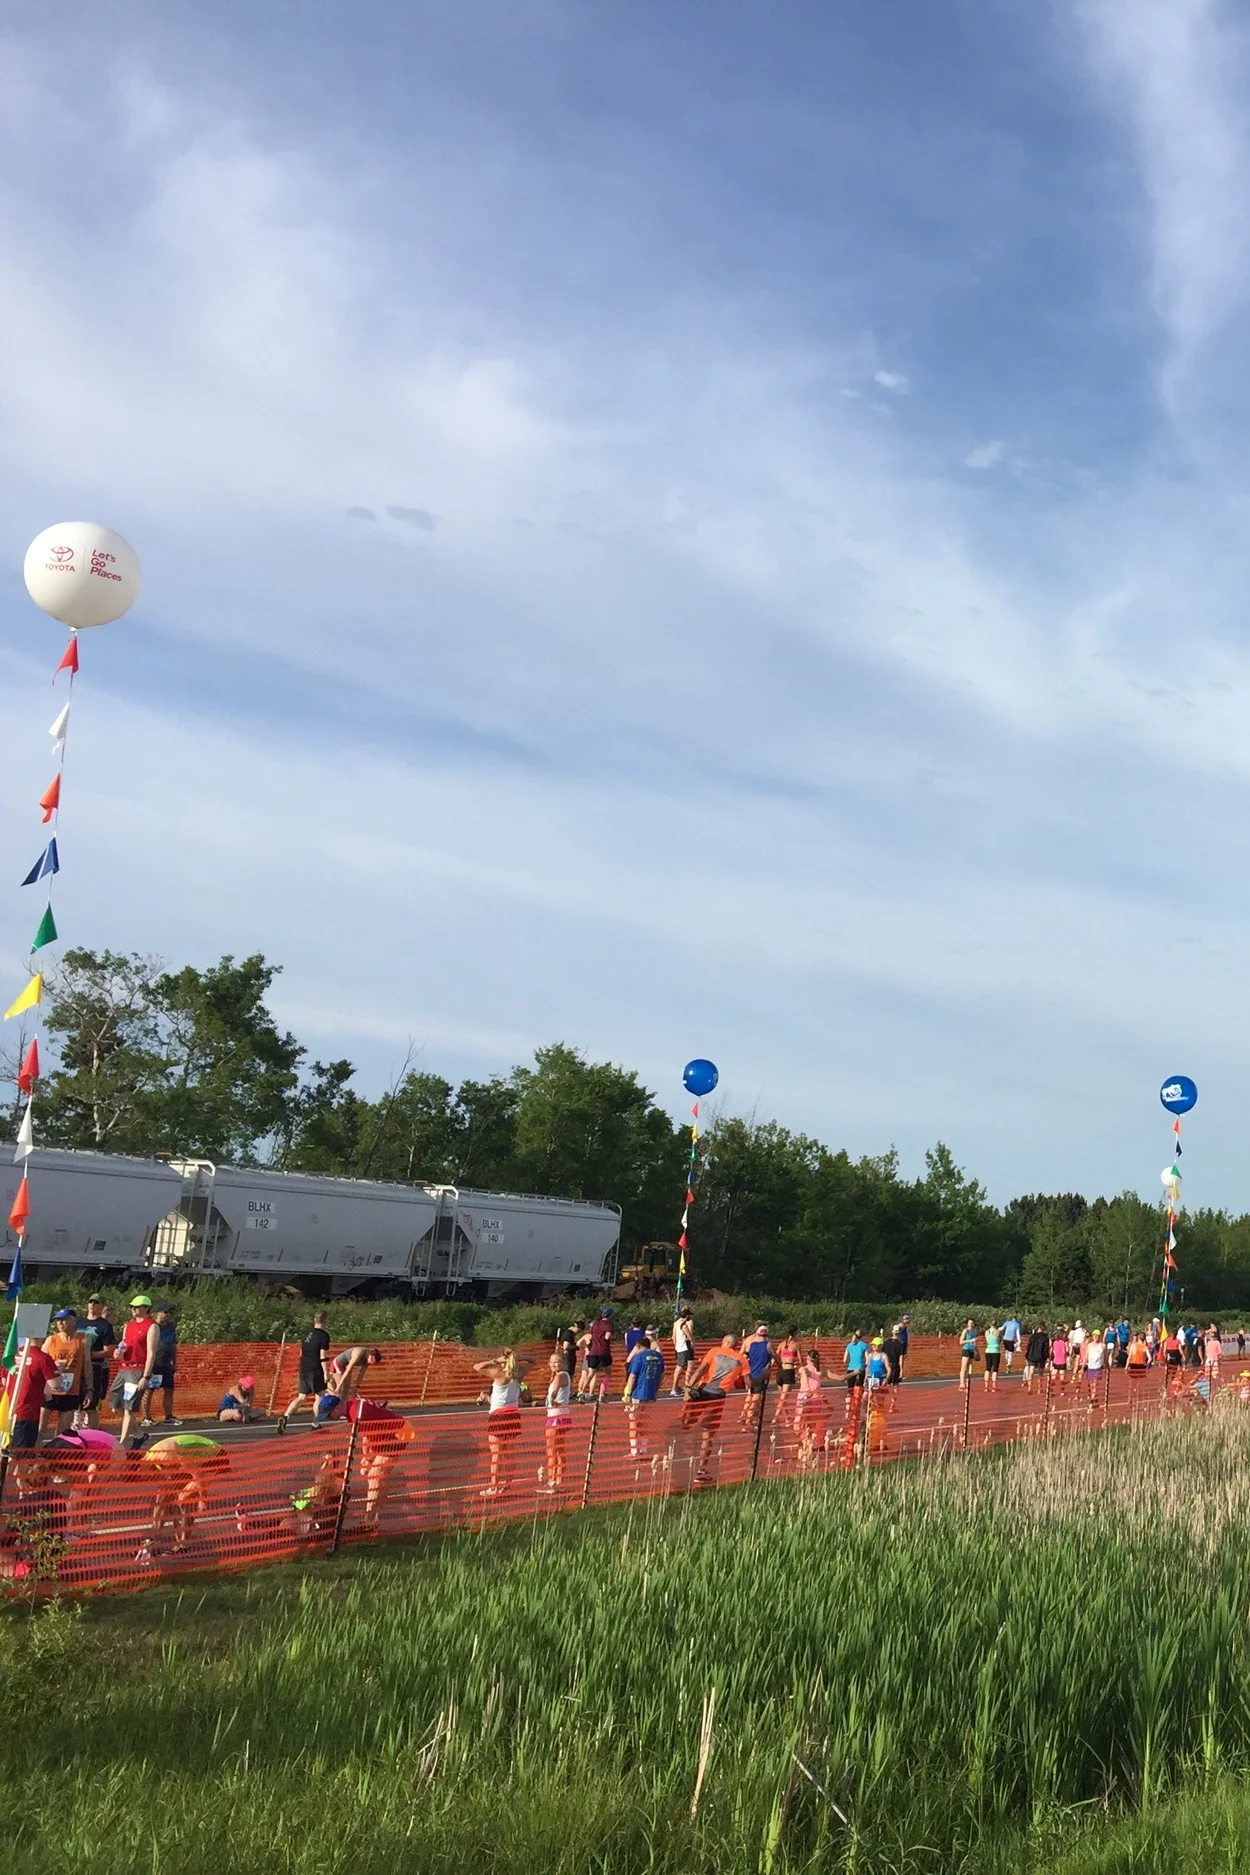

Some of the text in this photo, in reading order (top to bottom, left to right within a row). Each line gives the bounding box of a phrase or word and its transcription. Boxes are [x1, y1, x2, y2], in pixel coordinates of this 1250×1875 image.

[92, 549, 116, 563] Let's
[45, 564, 75, 572] TOYOTA
[90, 558, 106, 568] Go
[90, 566, 122, 581] Places
[248, 1201, 271, 1213] BLHX
[255, 1218, 269, 1229] 142
[483, 1219, 500, 1230] BLHX
[488, 1233, 499, 1243] 140
